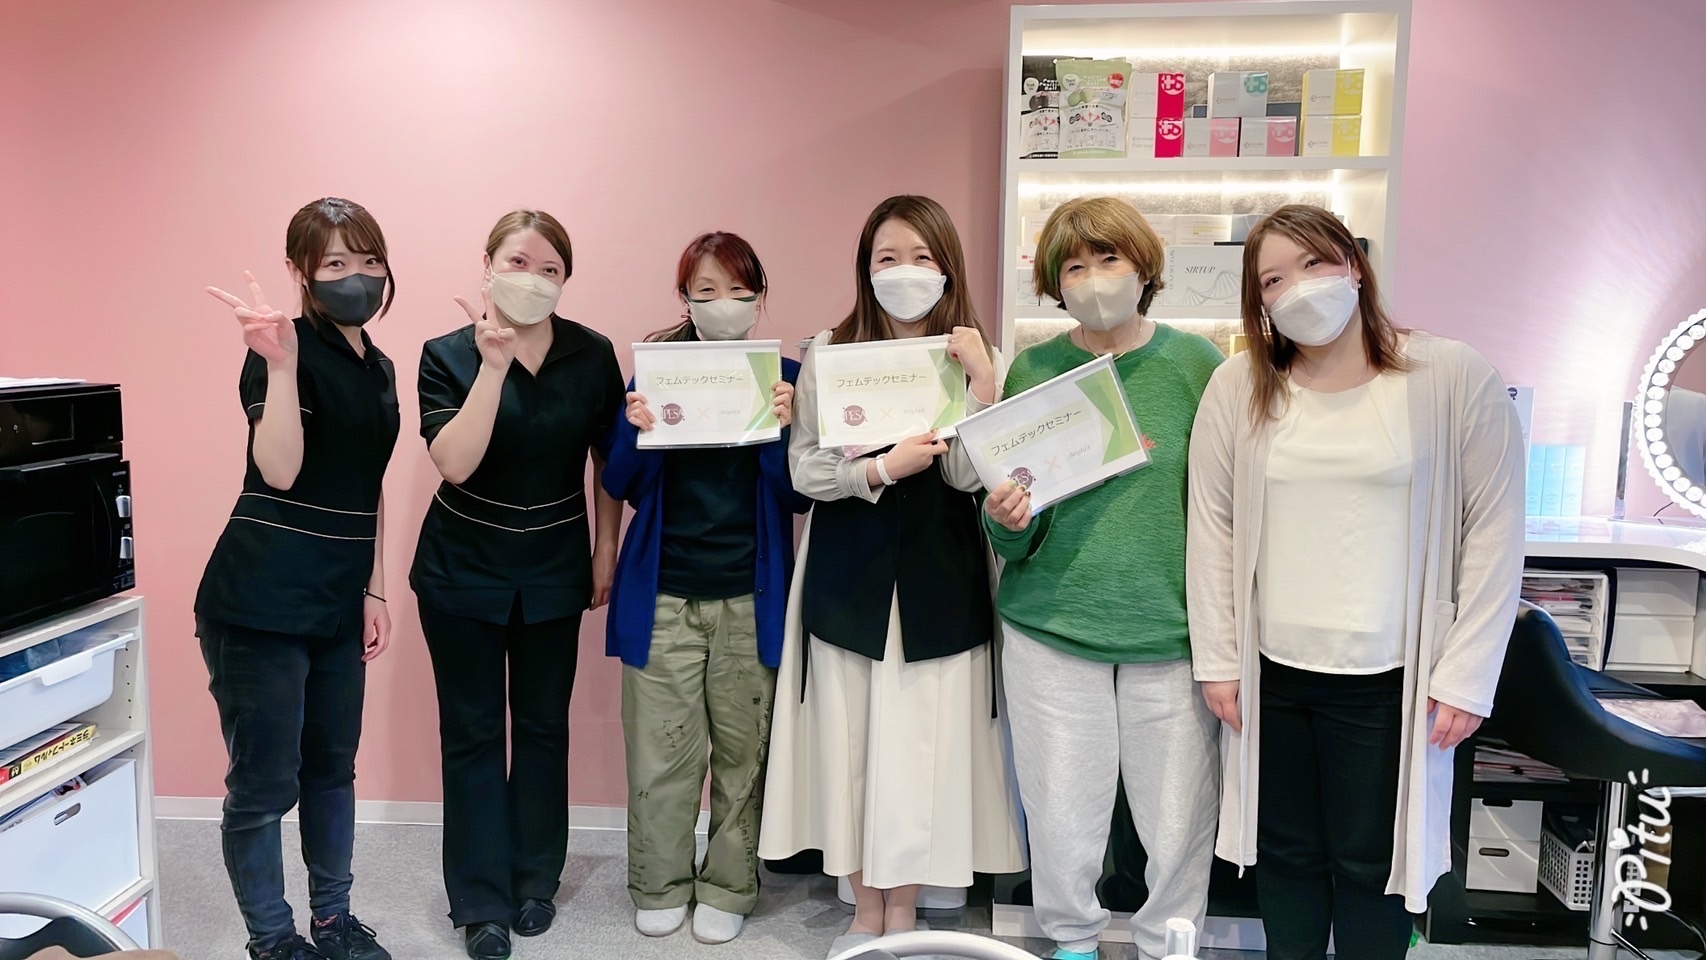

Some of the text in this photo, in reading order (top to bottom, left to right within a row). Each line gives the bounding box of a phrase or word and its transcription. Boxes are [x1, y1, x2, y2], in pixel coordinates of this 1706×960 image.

[656, 375, 744, 386] フェムテックセミナー
[836, 373, 927, 388] フェムテックセミナー
[991, 410, 1082, 456] フェムテックセミナー
[33, 729, 90, 765] ラミネートフィルム
